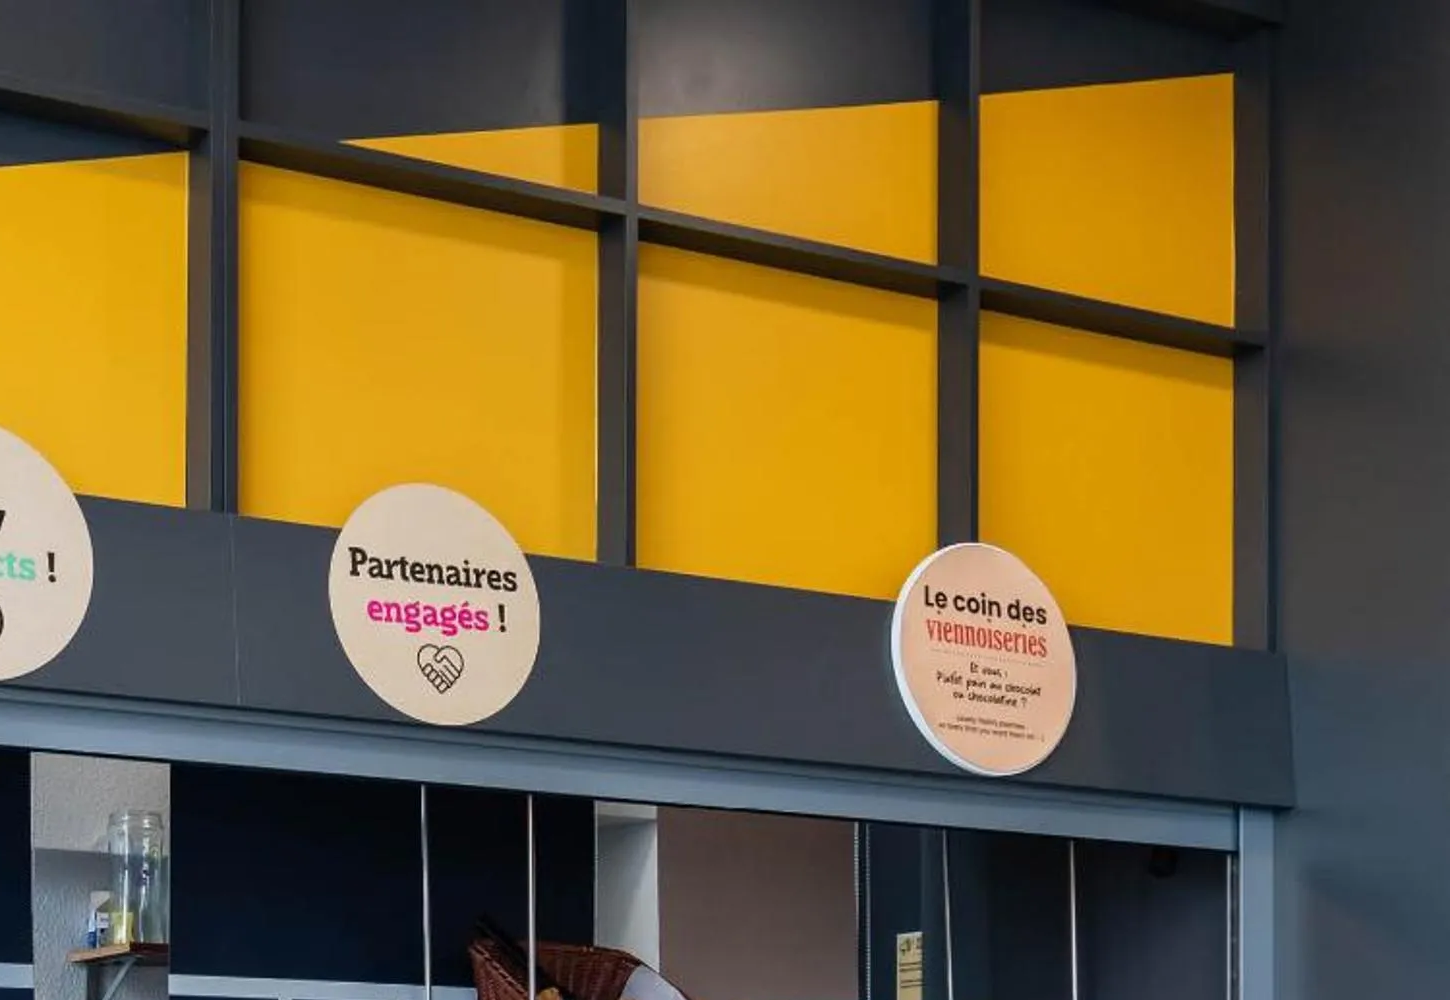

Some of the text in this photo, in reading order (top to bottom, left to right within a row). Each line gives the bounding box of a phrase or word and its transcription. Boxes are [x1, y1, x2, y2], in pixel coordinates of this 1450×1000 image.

[47, 551, 57, 583] !
[348, 547, 518, 592] Partenaires
[367, 600, 507, 637] engagés !
[924, 584, 1047, 625] Le coin des
